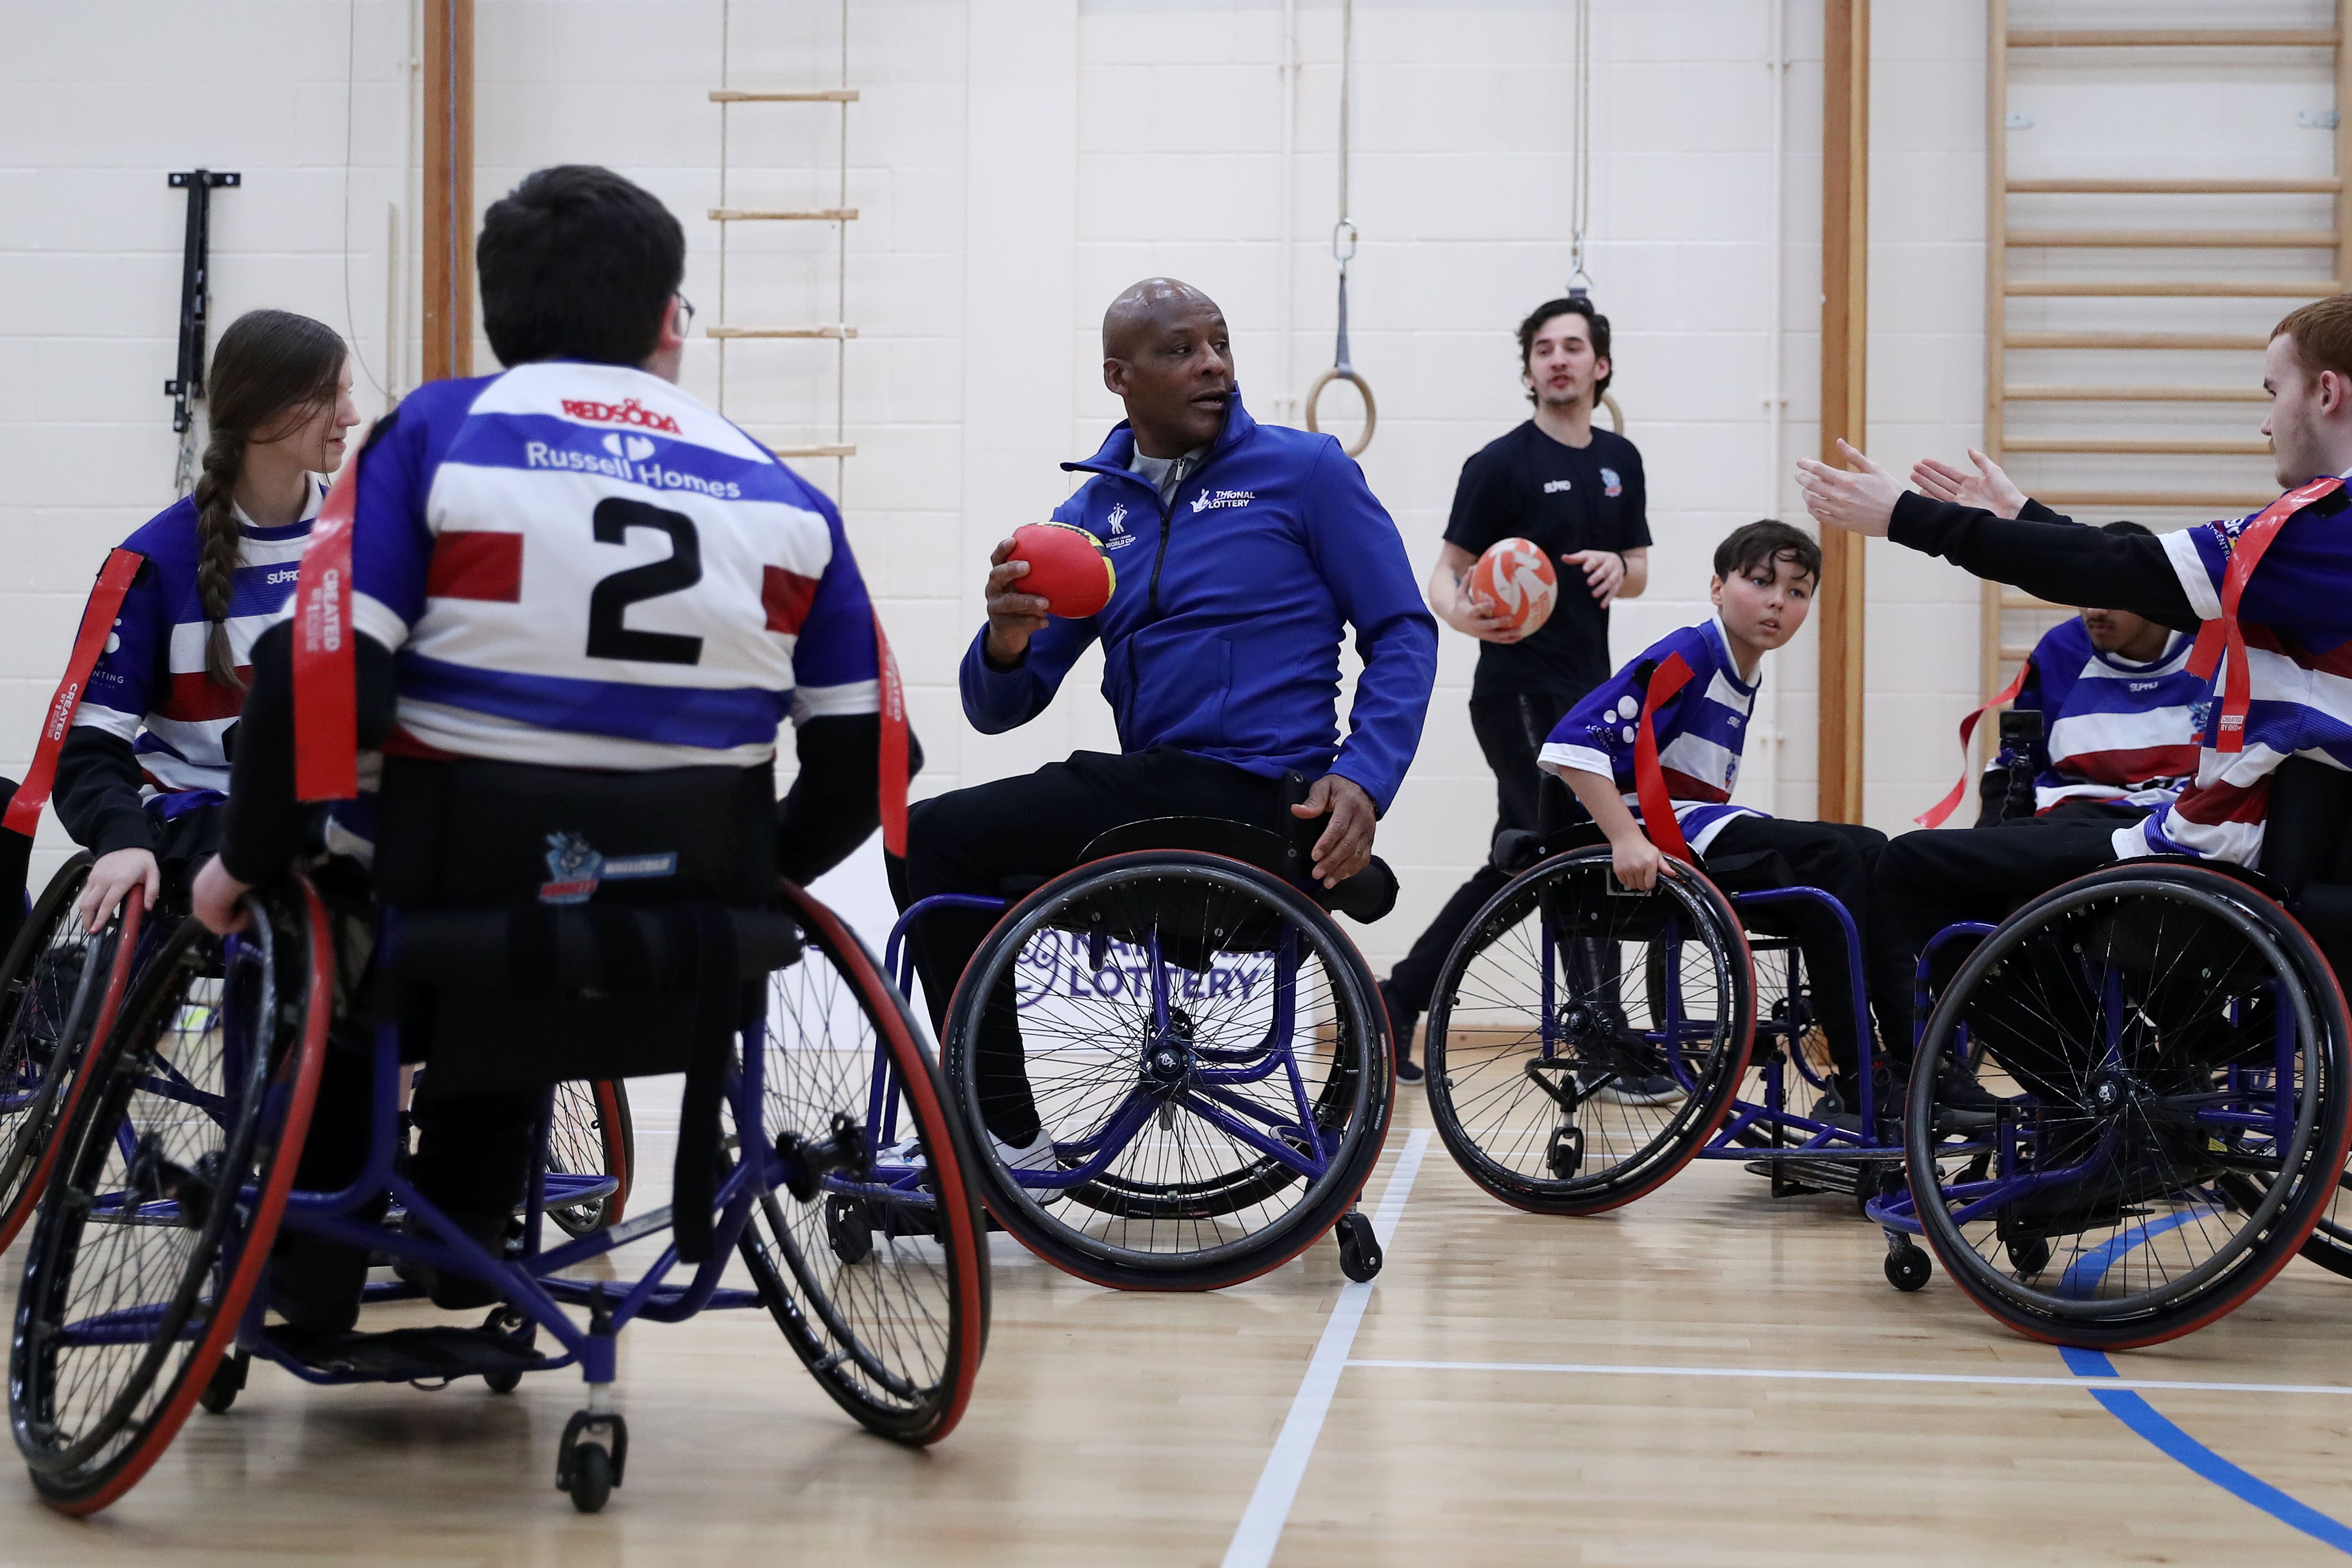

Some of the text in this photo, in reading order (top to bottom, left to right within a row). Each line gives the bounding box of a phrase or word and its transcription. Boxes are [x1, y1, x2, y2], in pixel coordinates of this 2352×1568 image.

[526, 441, 742, 499] Russell Homes
[1208, 499, 1249, 509] LOTTERY
[1105, 539, 1125, 548] WORLD
[322, 568, 340, 651] CREATED
[586, 496, 704, 666] 2
[54, 683, 78, 741] CREATED
